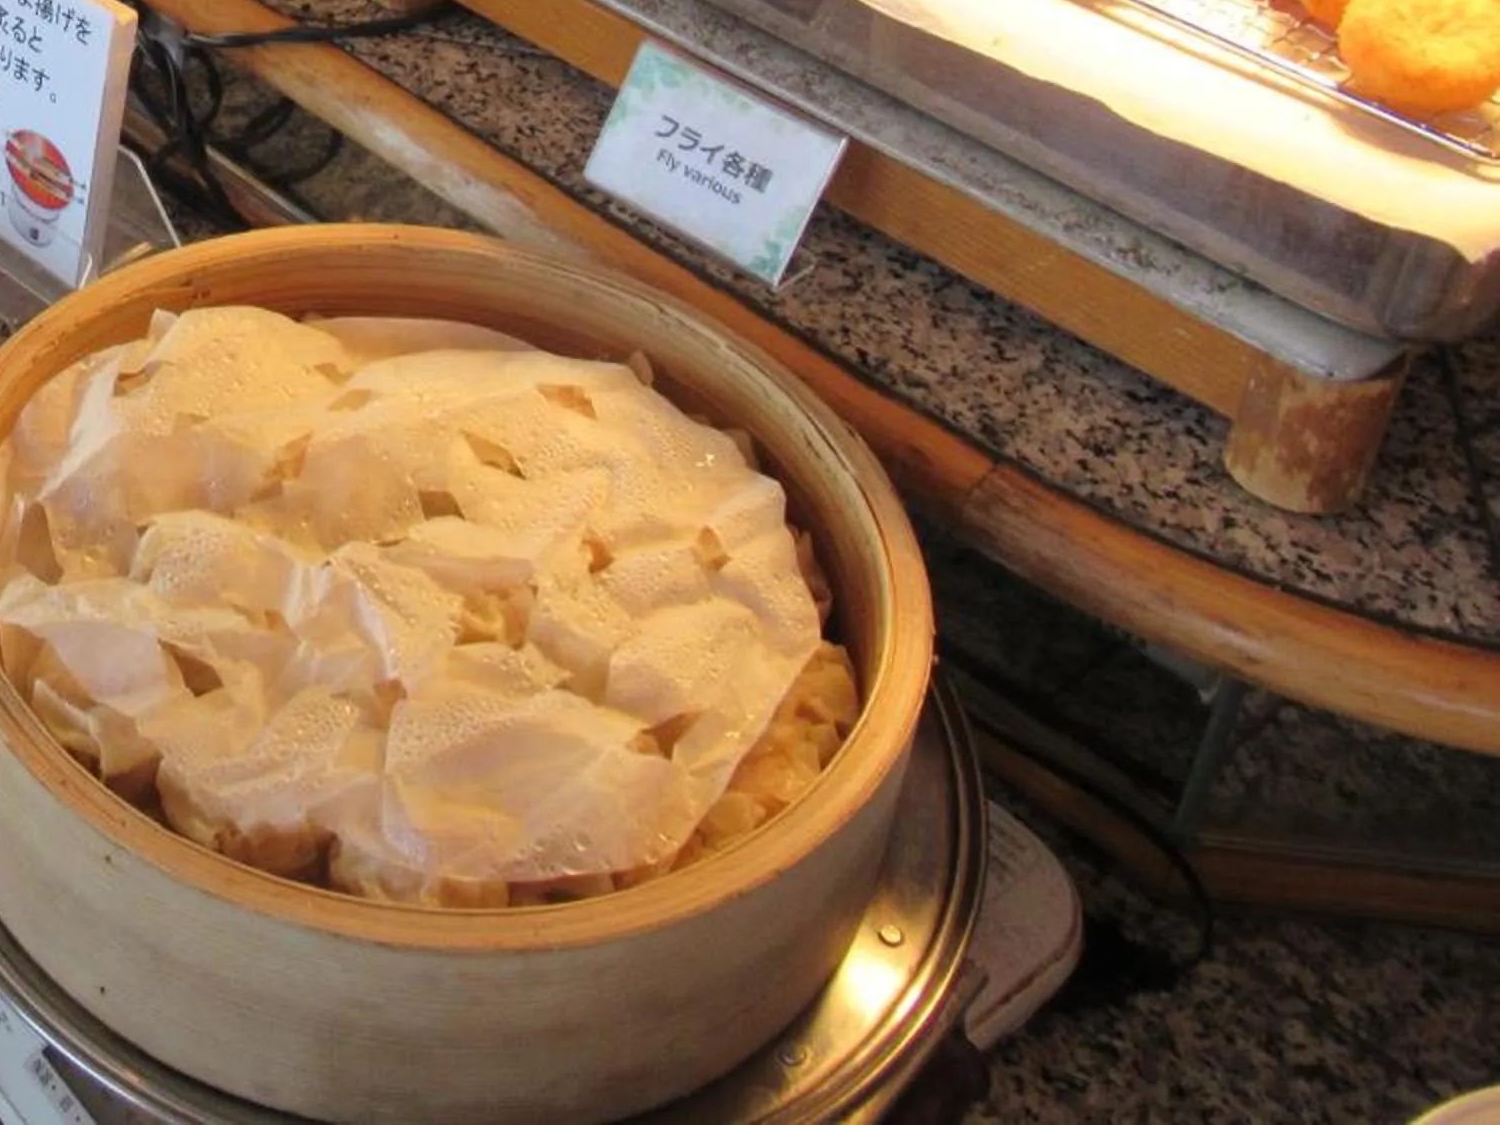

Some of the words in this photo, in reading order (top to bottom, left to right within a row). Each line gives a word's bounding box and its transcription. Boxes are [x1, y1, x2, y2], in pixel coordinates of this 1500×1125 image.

[654, 115, 773, 193] フライ各種
[656, 148, 681, 172] Fly
[683, 163, 742, 205] various
